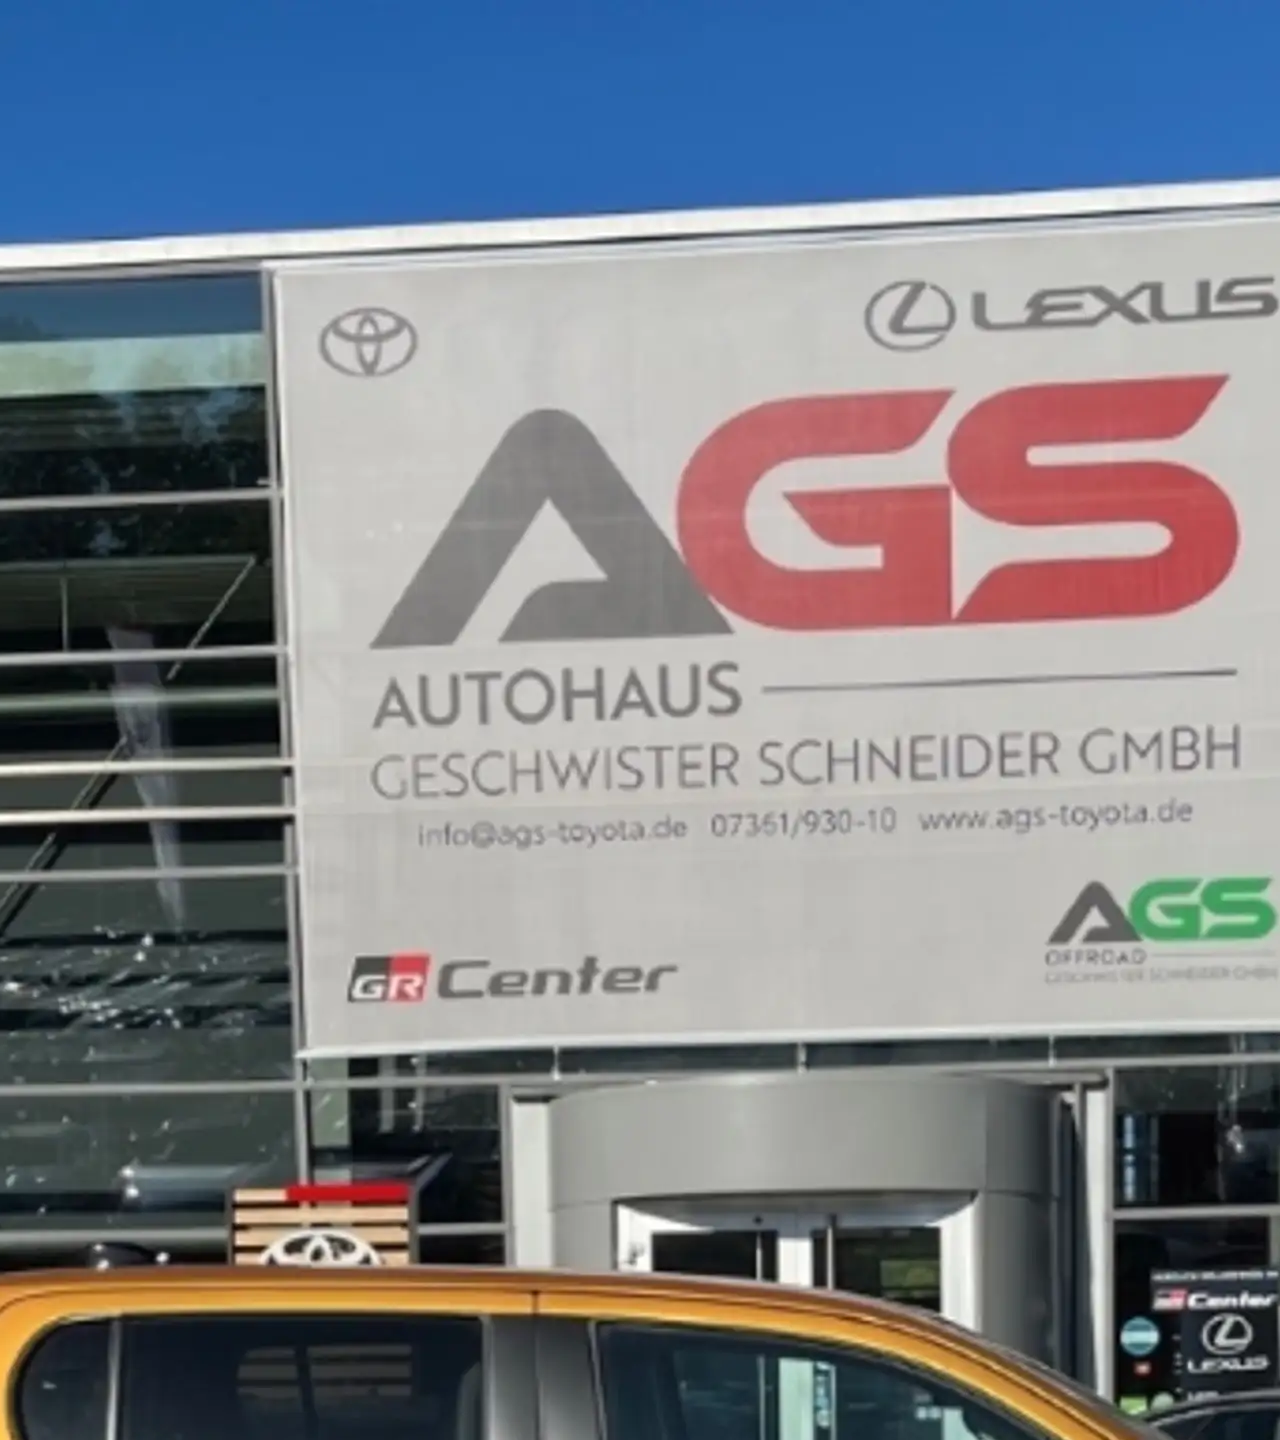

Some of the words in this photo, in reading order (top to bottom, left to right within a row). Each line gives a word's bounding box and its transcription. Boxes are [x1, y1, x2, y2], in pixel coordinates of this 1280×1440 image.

[971, 276, 1280, 331] LEXUS
[370, 374, 1241, 650] AGS
[372, 661, 743, 729] AUTOHAUS
[370, 741, 741, 801] GESCHWISTER
[759, 731, 1061, 788] SCHNEIDER
[1078, 723, 1242, 776] GMBH
[417, 813, 689, 850] info@ags-toyota.de
[710, 806, 898, 840] 07361/930-10
[919, 798, 1195, 835] www.ags-toyota.de
[1046, 877, 1278, 944] AGS
[350, 972, 426, 1001] GR
[437, 956, 678, 1000] Center
[1045, 948, 1148, 967] OFFROAD
[1187, 1355, 1271, 1374] LEXUS
